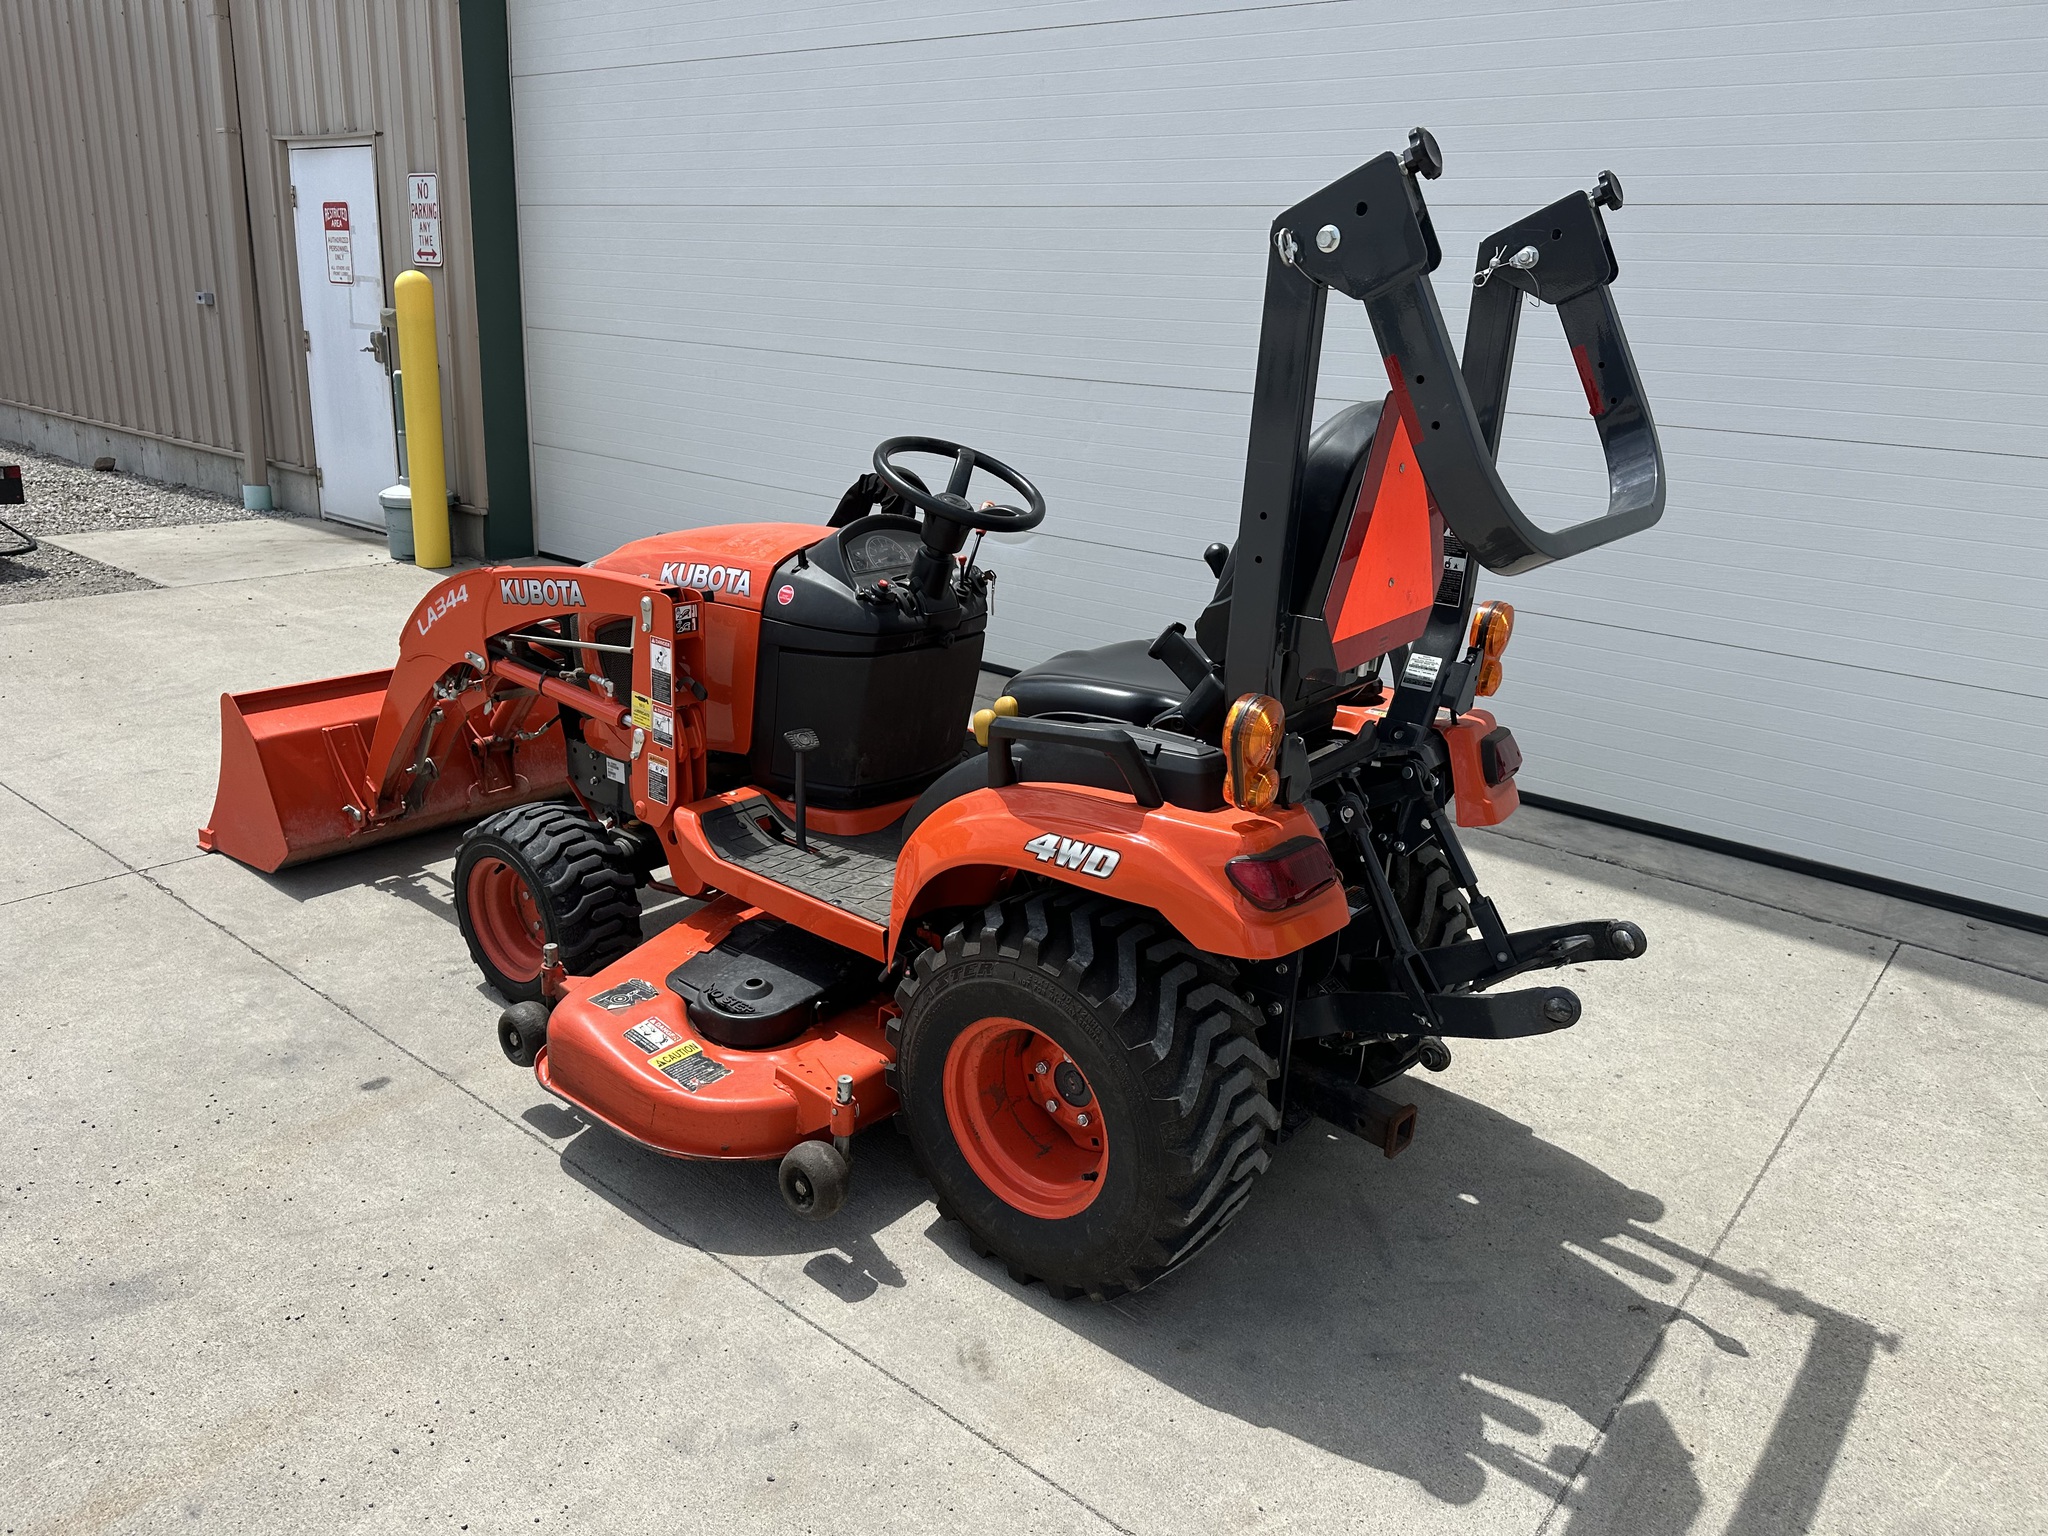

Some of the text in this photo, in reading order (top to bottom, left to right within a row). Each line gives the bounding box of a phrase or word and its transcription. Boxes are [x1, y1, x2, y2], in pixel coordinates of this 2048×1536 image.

[417, 182, 429, 200] NO
[324, 207, 348, 222] RESTRICTED
[411, 202, 437, 220] PARKING
[331, 219, 343, 228] AREA
[419, 221, 431, 233] ANY
[328, 236, 349, 244] AUTHORIZED
[329, 245, 349, 253] PERSONNEL
[418, 235, 433, 247] TIME
[659, 562, 752, 598] KUBOTA
[500, 578, 587, 607] KUBOTA
[416, 583, 469, 636] LA344
[1023, 832, 1122, 879] 4WD
[703, 982, 756, 1013] NO STEP
[654, 1022, 680, 1042] DANGER
[662, 1043, 699, 1064] CAUTION
